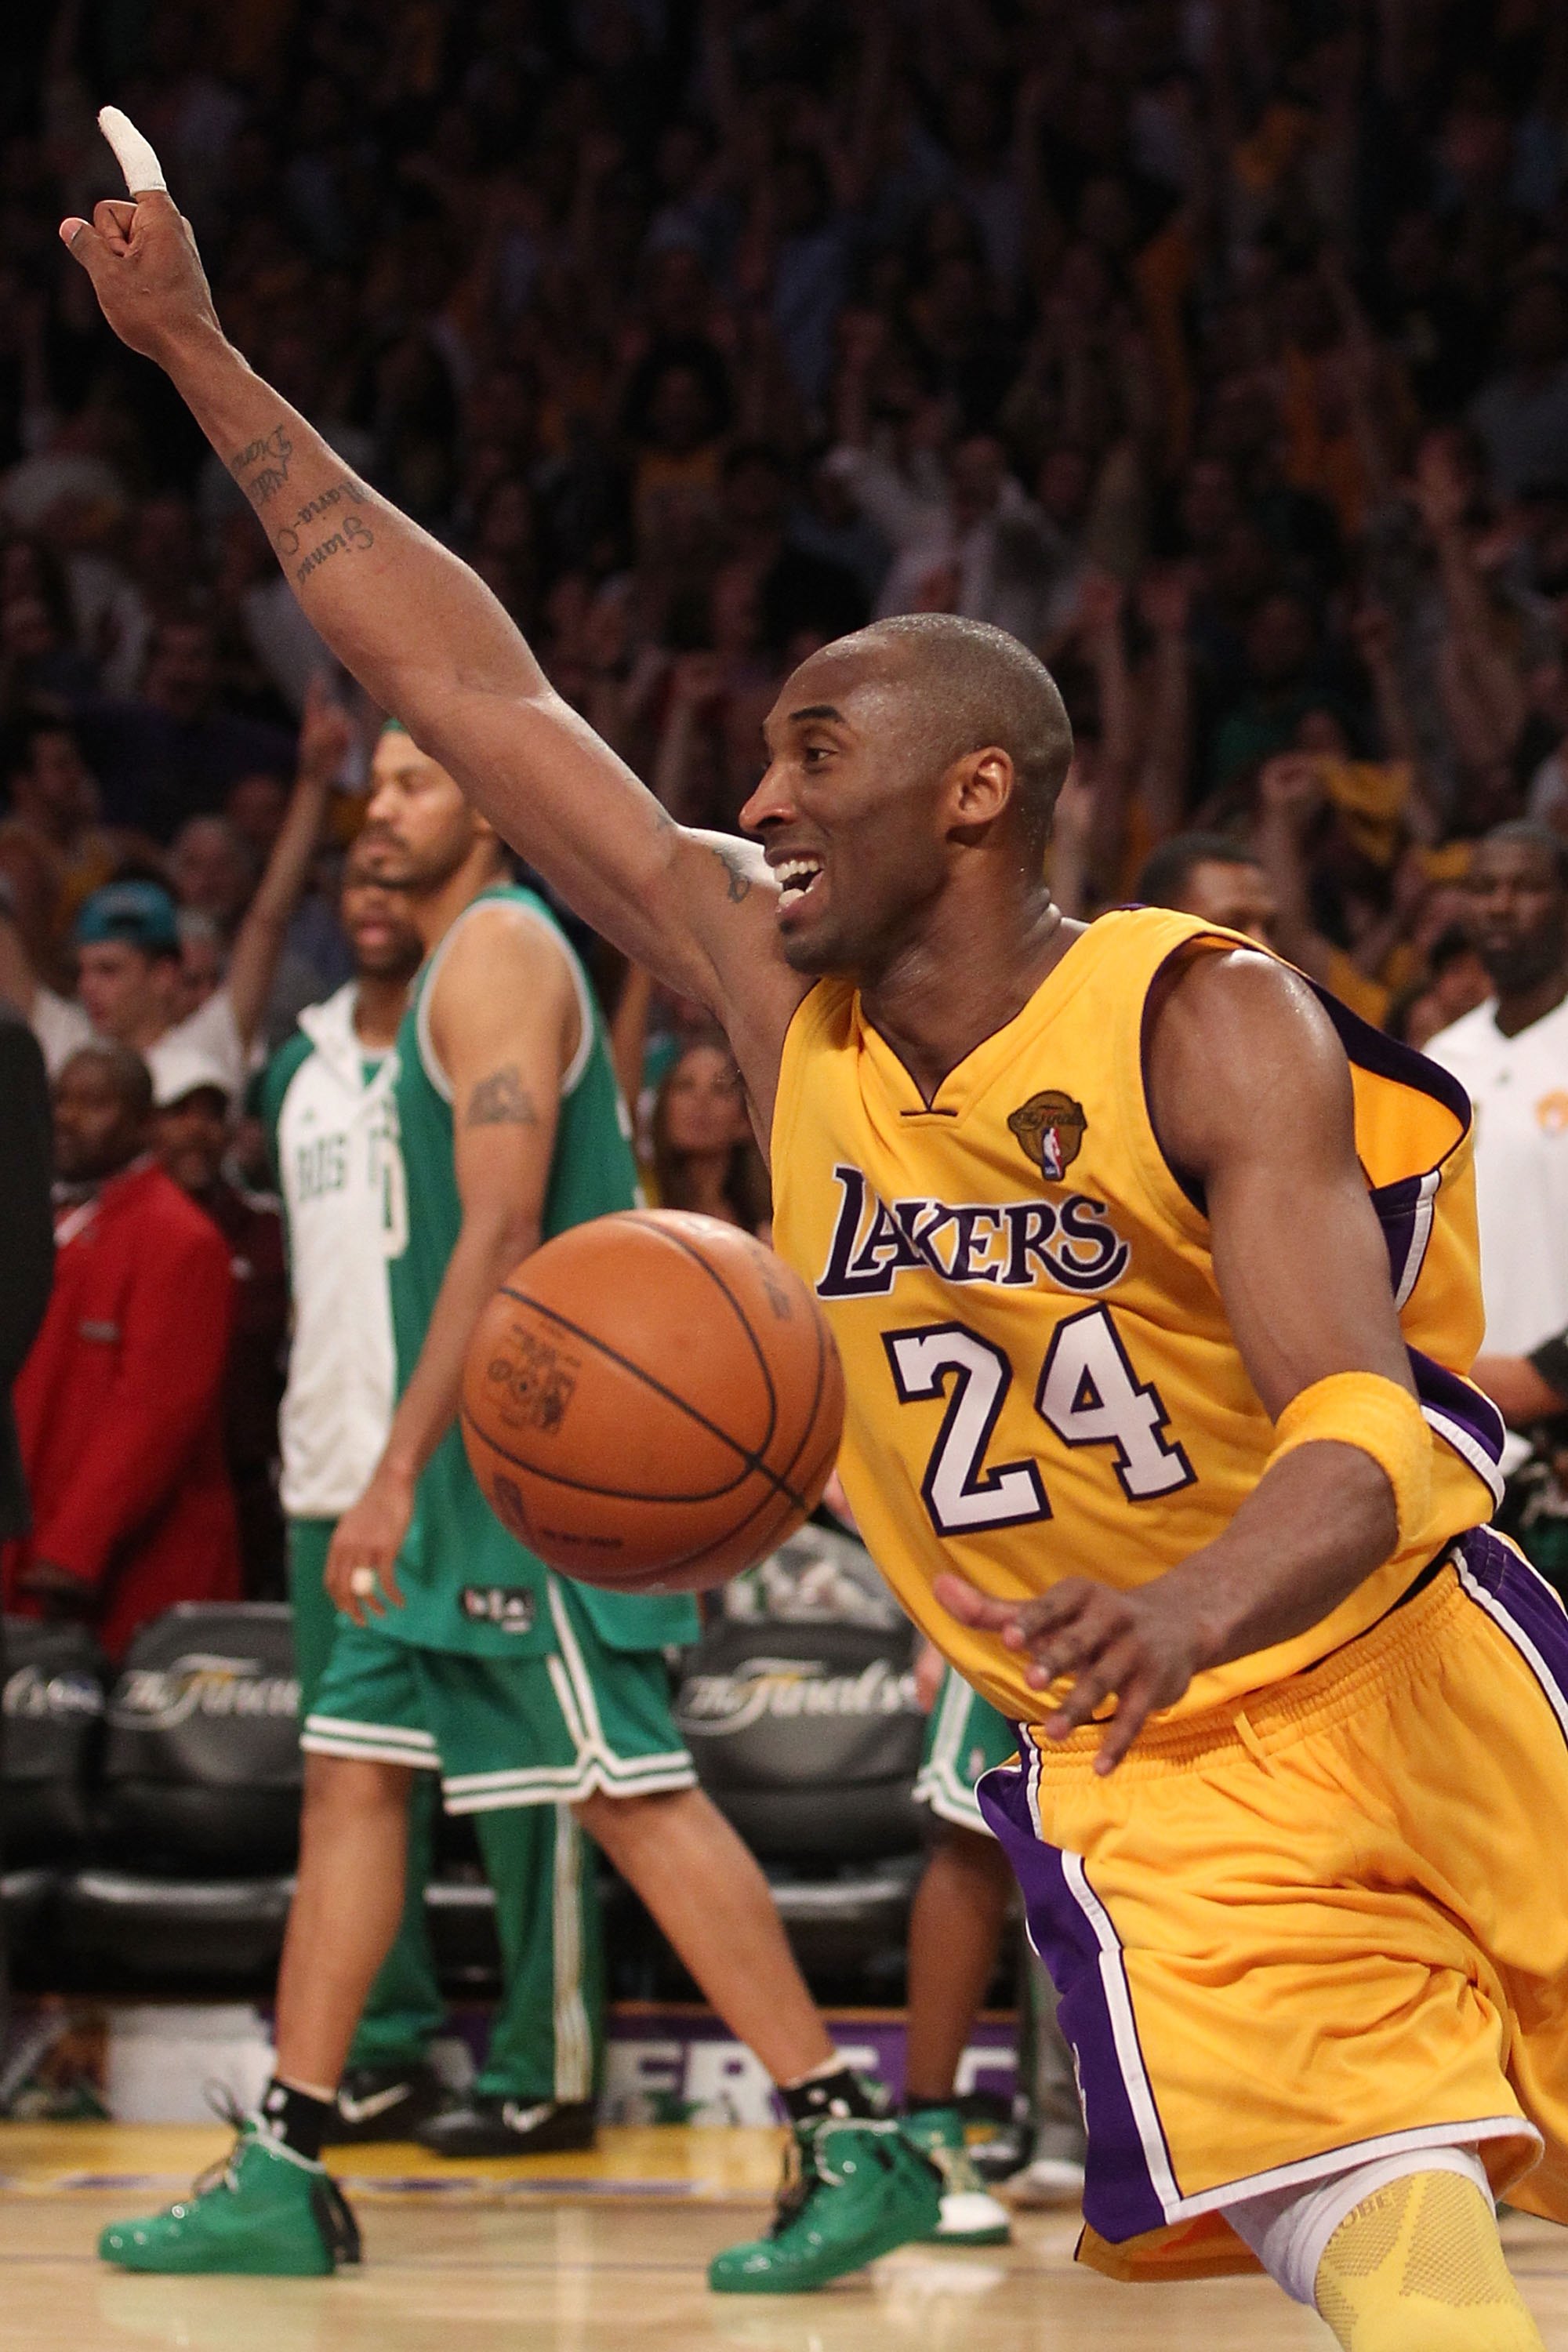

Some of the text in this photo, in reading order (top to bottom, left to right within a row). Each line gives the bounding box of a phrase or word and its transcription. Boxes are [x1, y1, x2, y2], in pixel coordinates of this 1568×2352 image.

[297, 516, 375, 586] Gianna
[815, 1163, 1131, 1300] LAKERS
[880, 1300, 1200, 1538] 24
